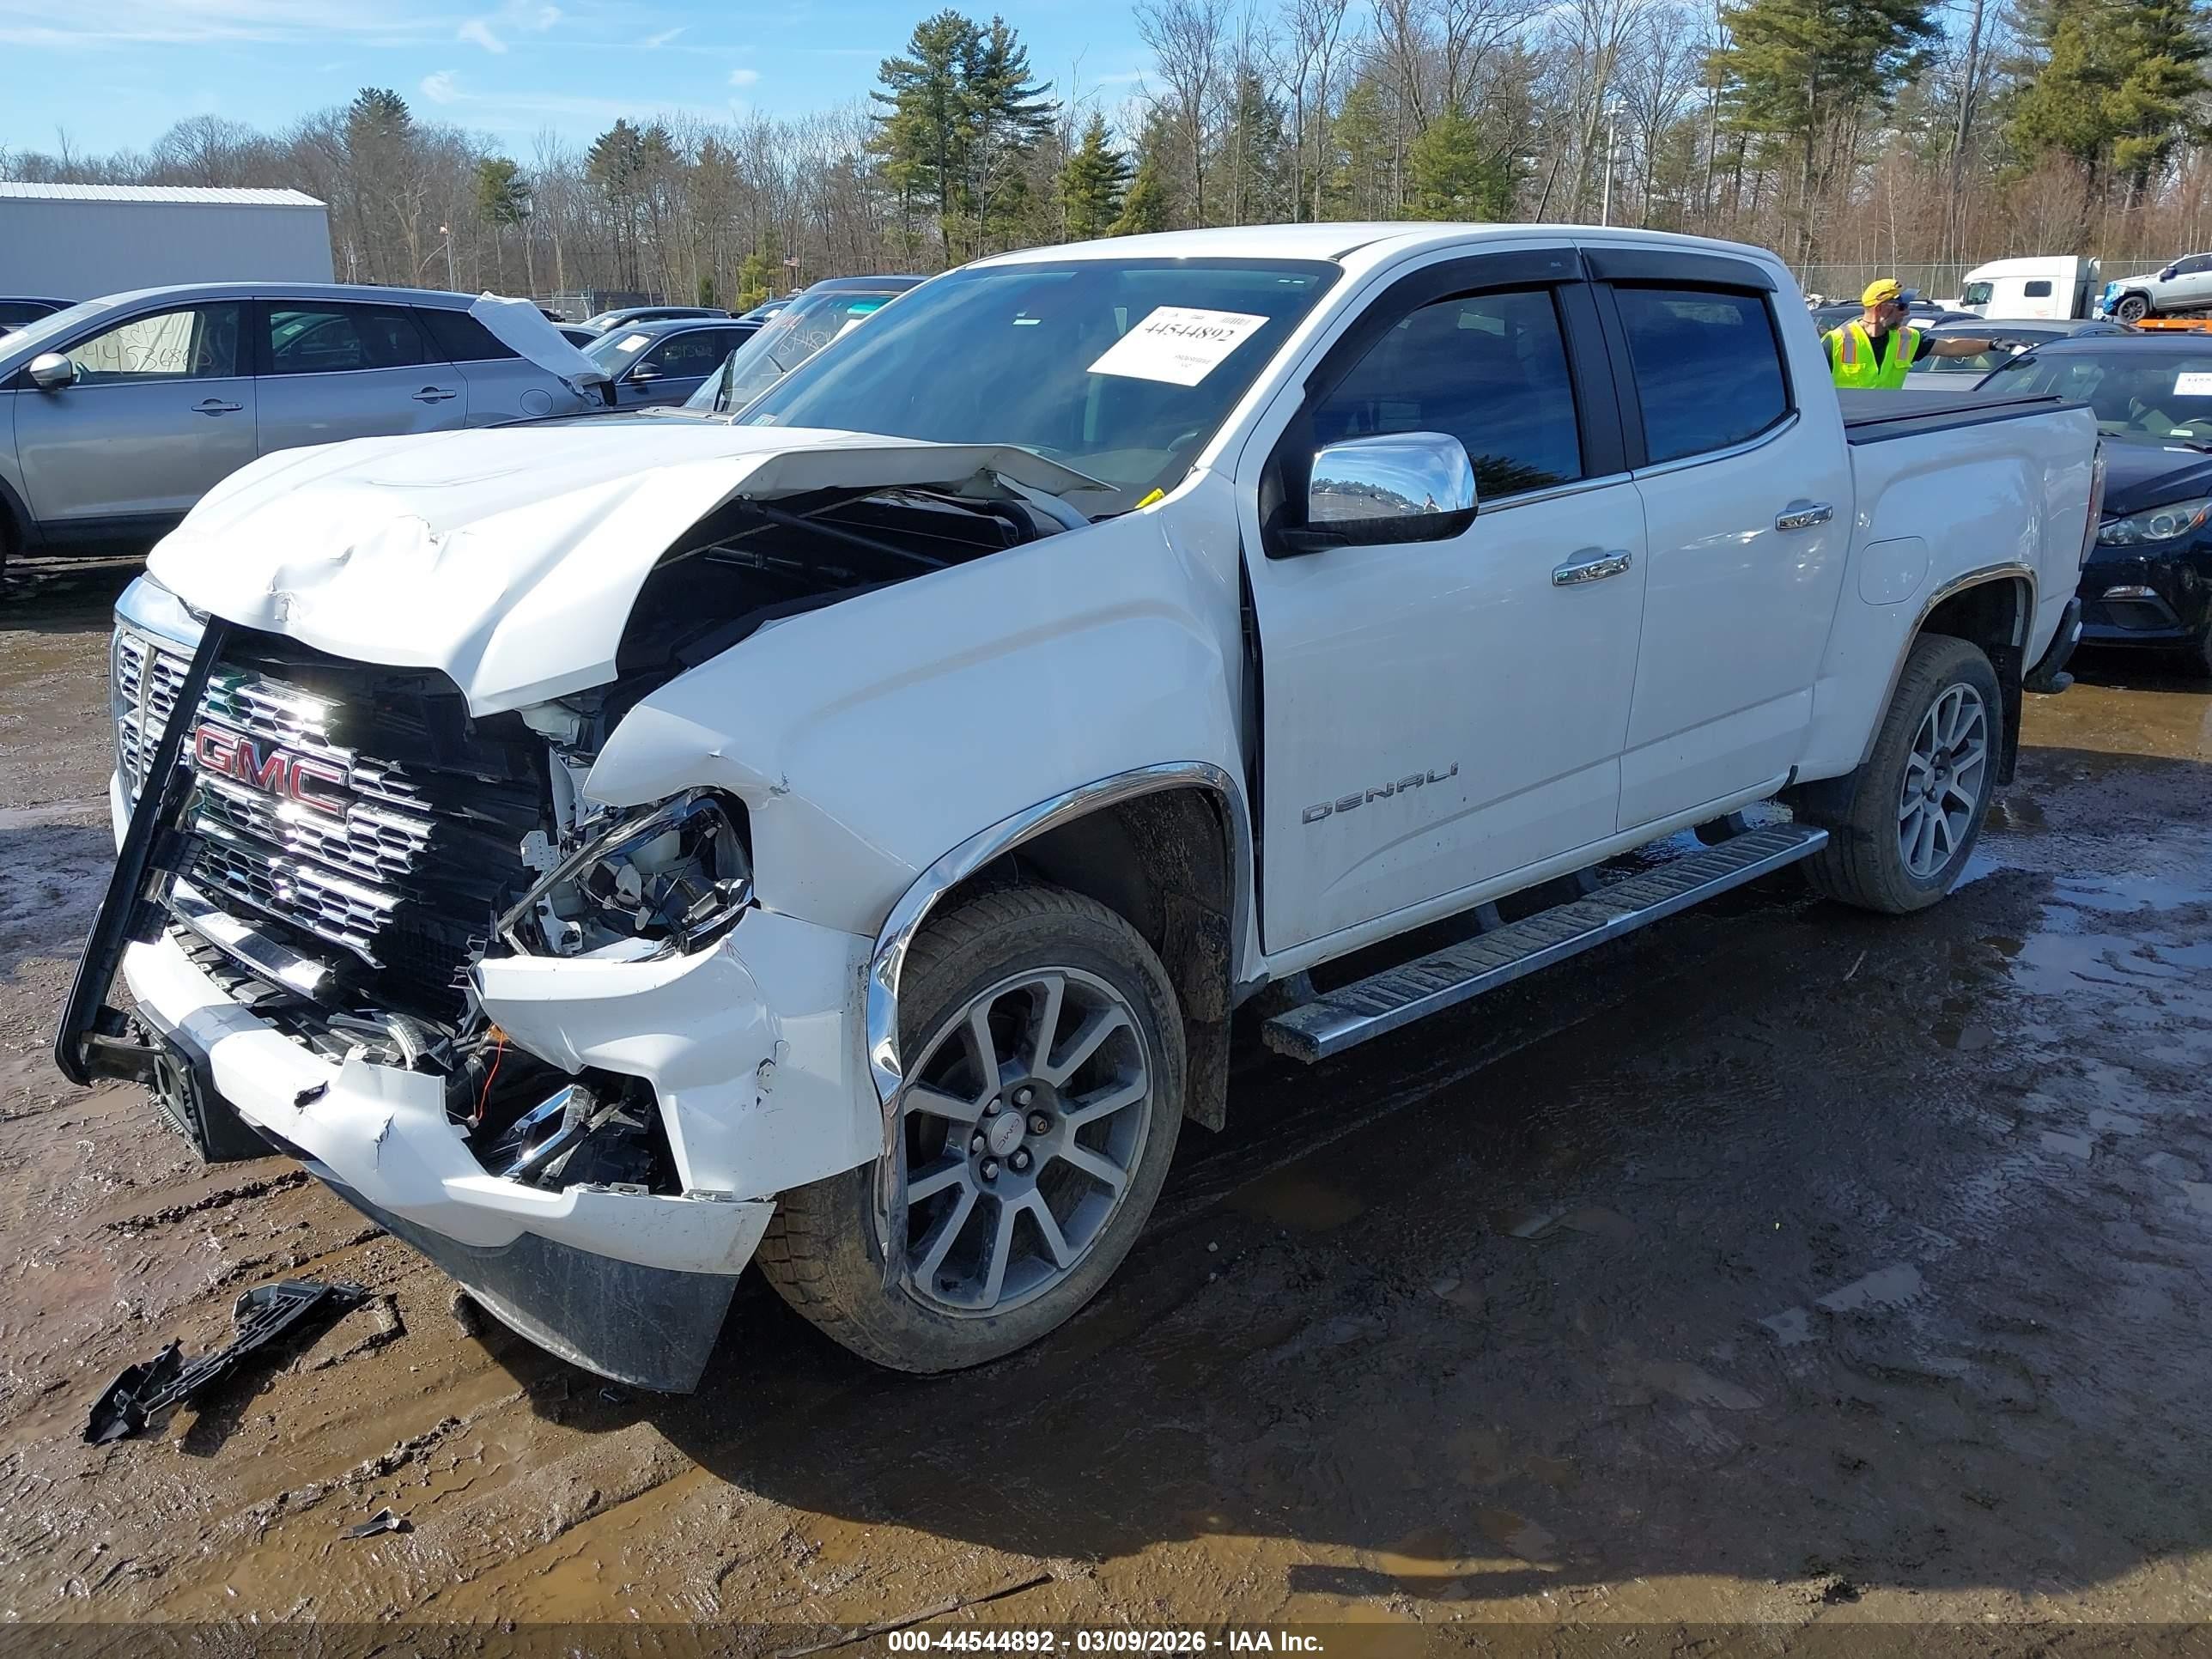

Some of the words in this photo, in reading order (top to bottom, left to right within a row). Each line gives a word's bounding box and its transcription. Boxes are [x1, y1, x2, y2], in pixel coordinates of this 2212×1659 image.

[1145, 322, 1235, 342] 44544892
[195, 723, 348, 817] GMC
[1302, 762, 1459, 825] DENALI
[995, 1118, 1020, 1151] GMC
